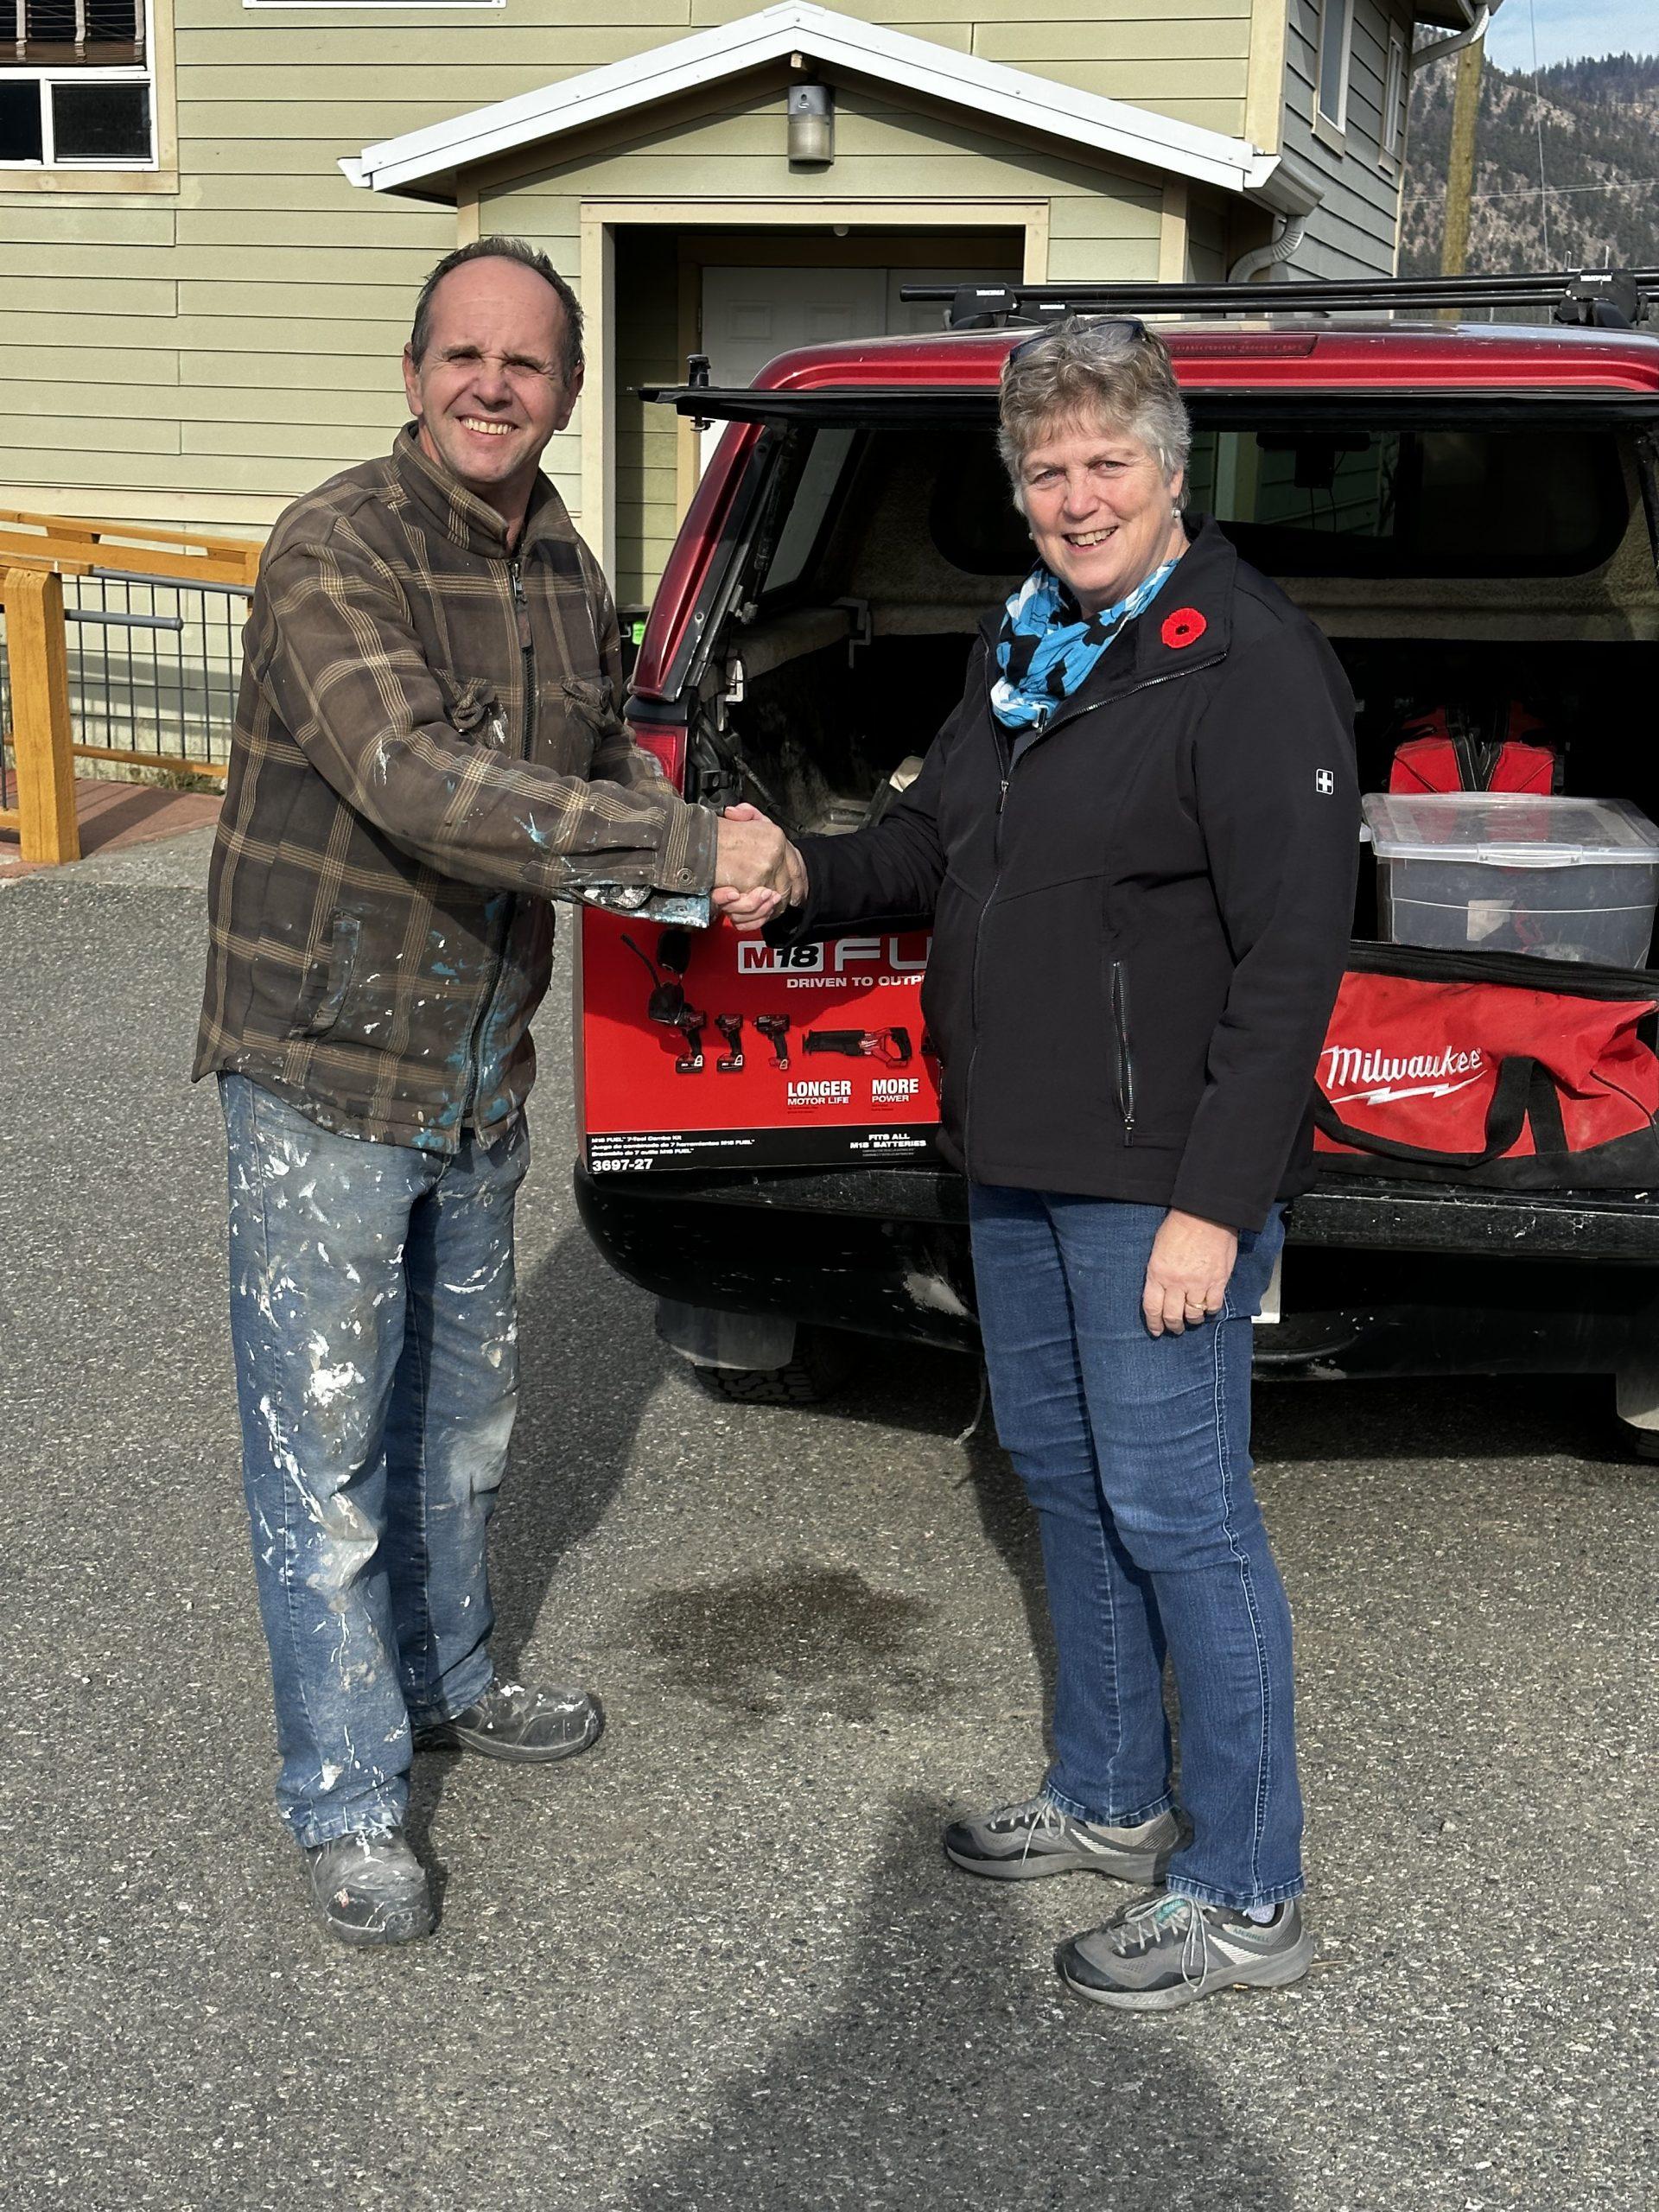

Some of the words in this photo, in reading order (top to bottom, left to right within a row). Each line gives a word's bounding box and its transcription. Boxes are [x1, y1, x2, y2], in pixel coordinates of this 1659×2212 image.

[743, 945, 820, 969] M18
[835, 938, 932, 972] FU
[786, 977, 847, 988] DRIVEN
[852, 976, 874, 987] TO
[878, 975, 925, 986] OUTP
[787, 1080, 852, 1097] LONGER
[872, 1077, 919, 1095] MORE
[787, 1096, 826, 1106] MOTOR
[828, 1096, 849, 1104] LIFE
[871, 1095, 910, 1103] POWER
[873, 1140, 927, 1148] BATTERIES
[592, 1158, 653, 1172] 3697-27
